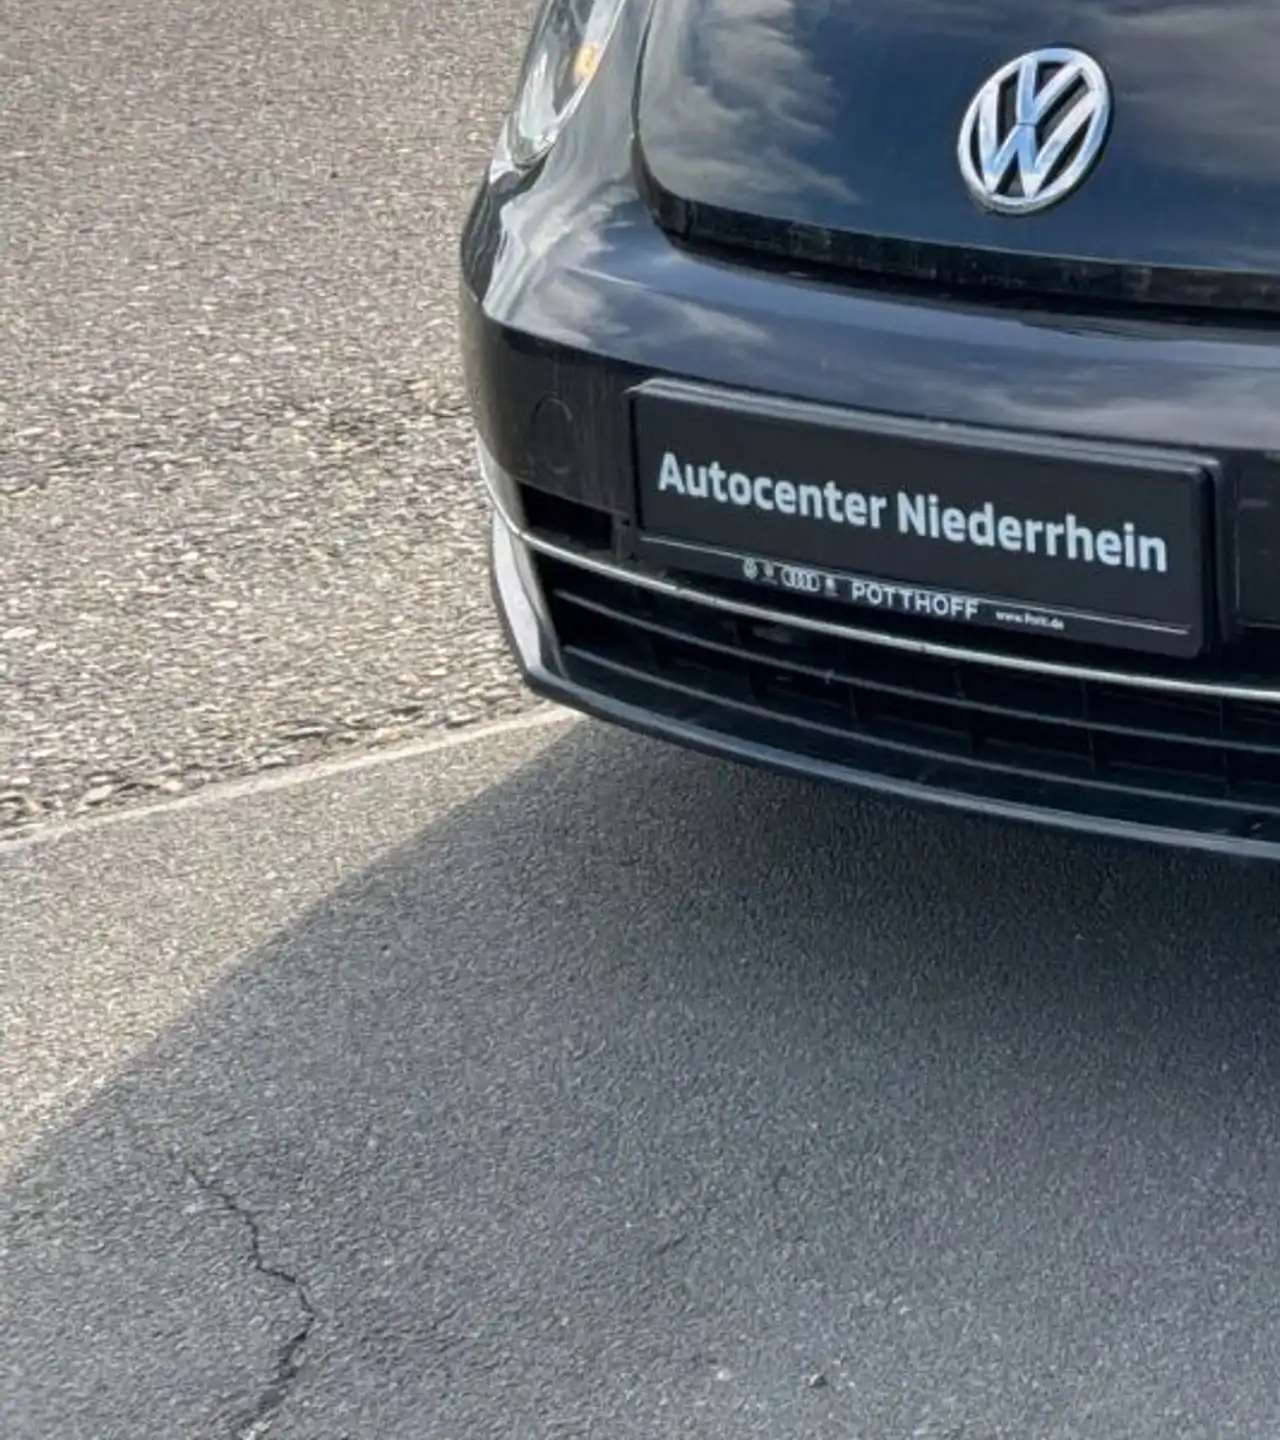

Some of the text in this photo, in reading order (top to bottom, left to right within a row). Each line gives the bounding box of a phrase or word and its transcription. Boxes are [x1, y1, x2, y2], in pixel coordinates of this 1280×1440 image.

[957, 47, 1111, 214] VW
[657, 452, 1167, 573] Autocenter Niederrhein
[852, 578, 979, 620] POTTHOFF
